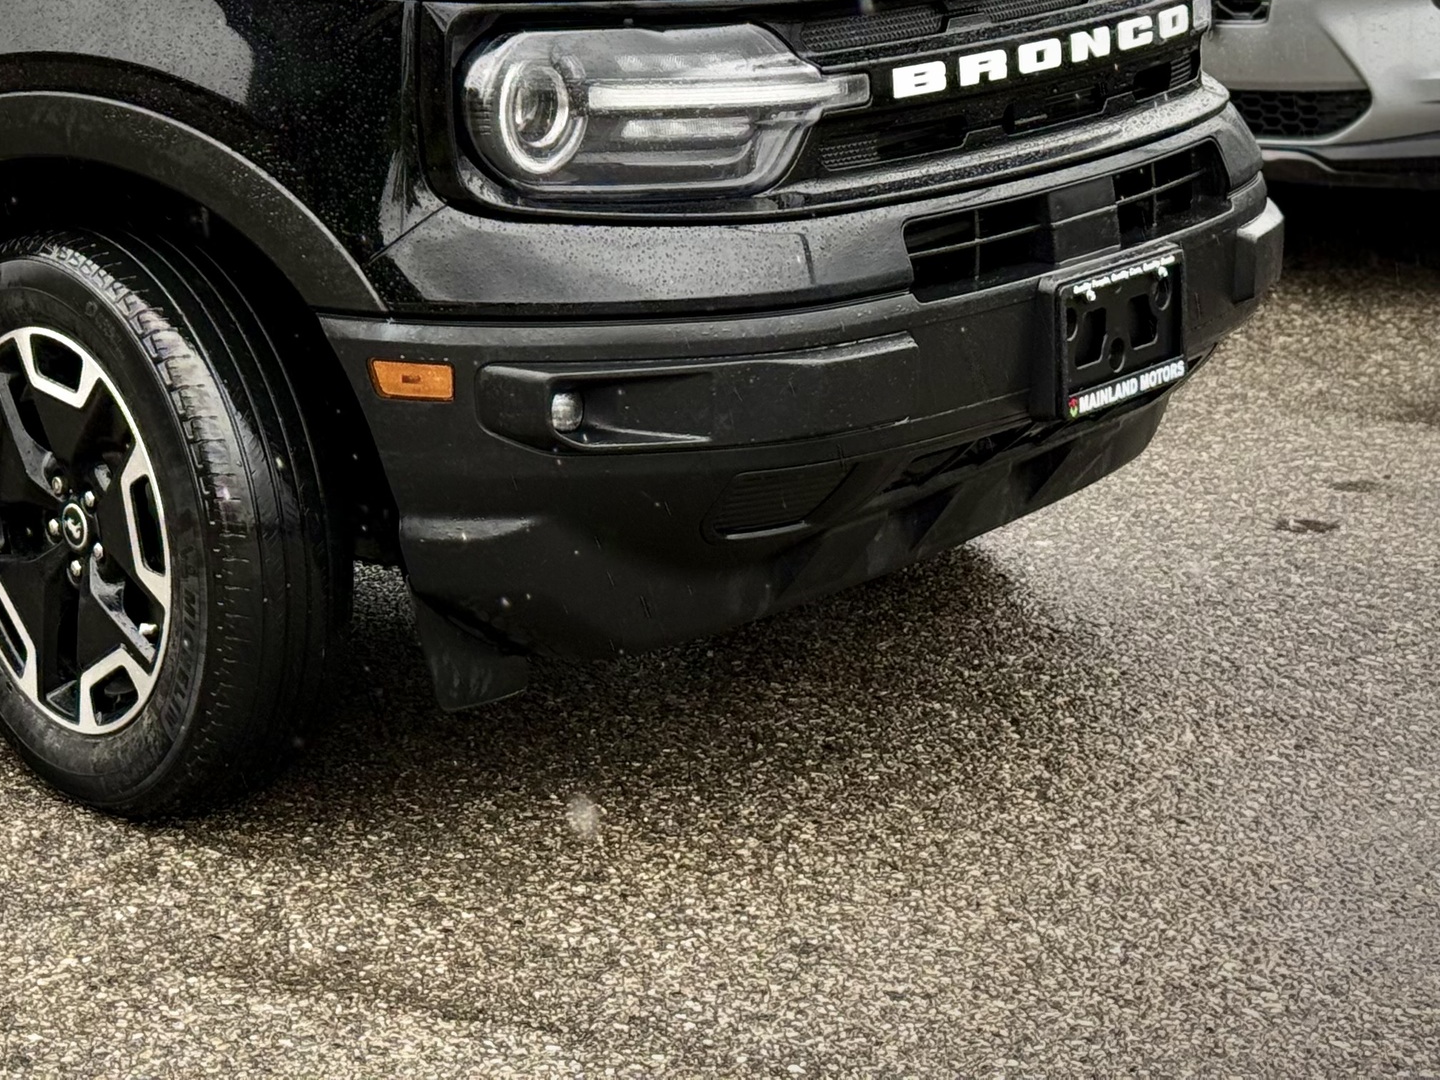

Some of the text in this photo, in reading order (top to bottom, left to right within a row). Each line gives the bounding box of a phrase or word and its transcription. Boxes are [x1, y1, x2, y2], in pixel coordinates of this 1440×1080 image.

[892, 3, 1190, 99] BRONCO
[1079, 360, 1185, 414] MAINLAND MOTORS
